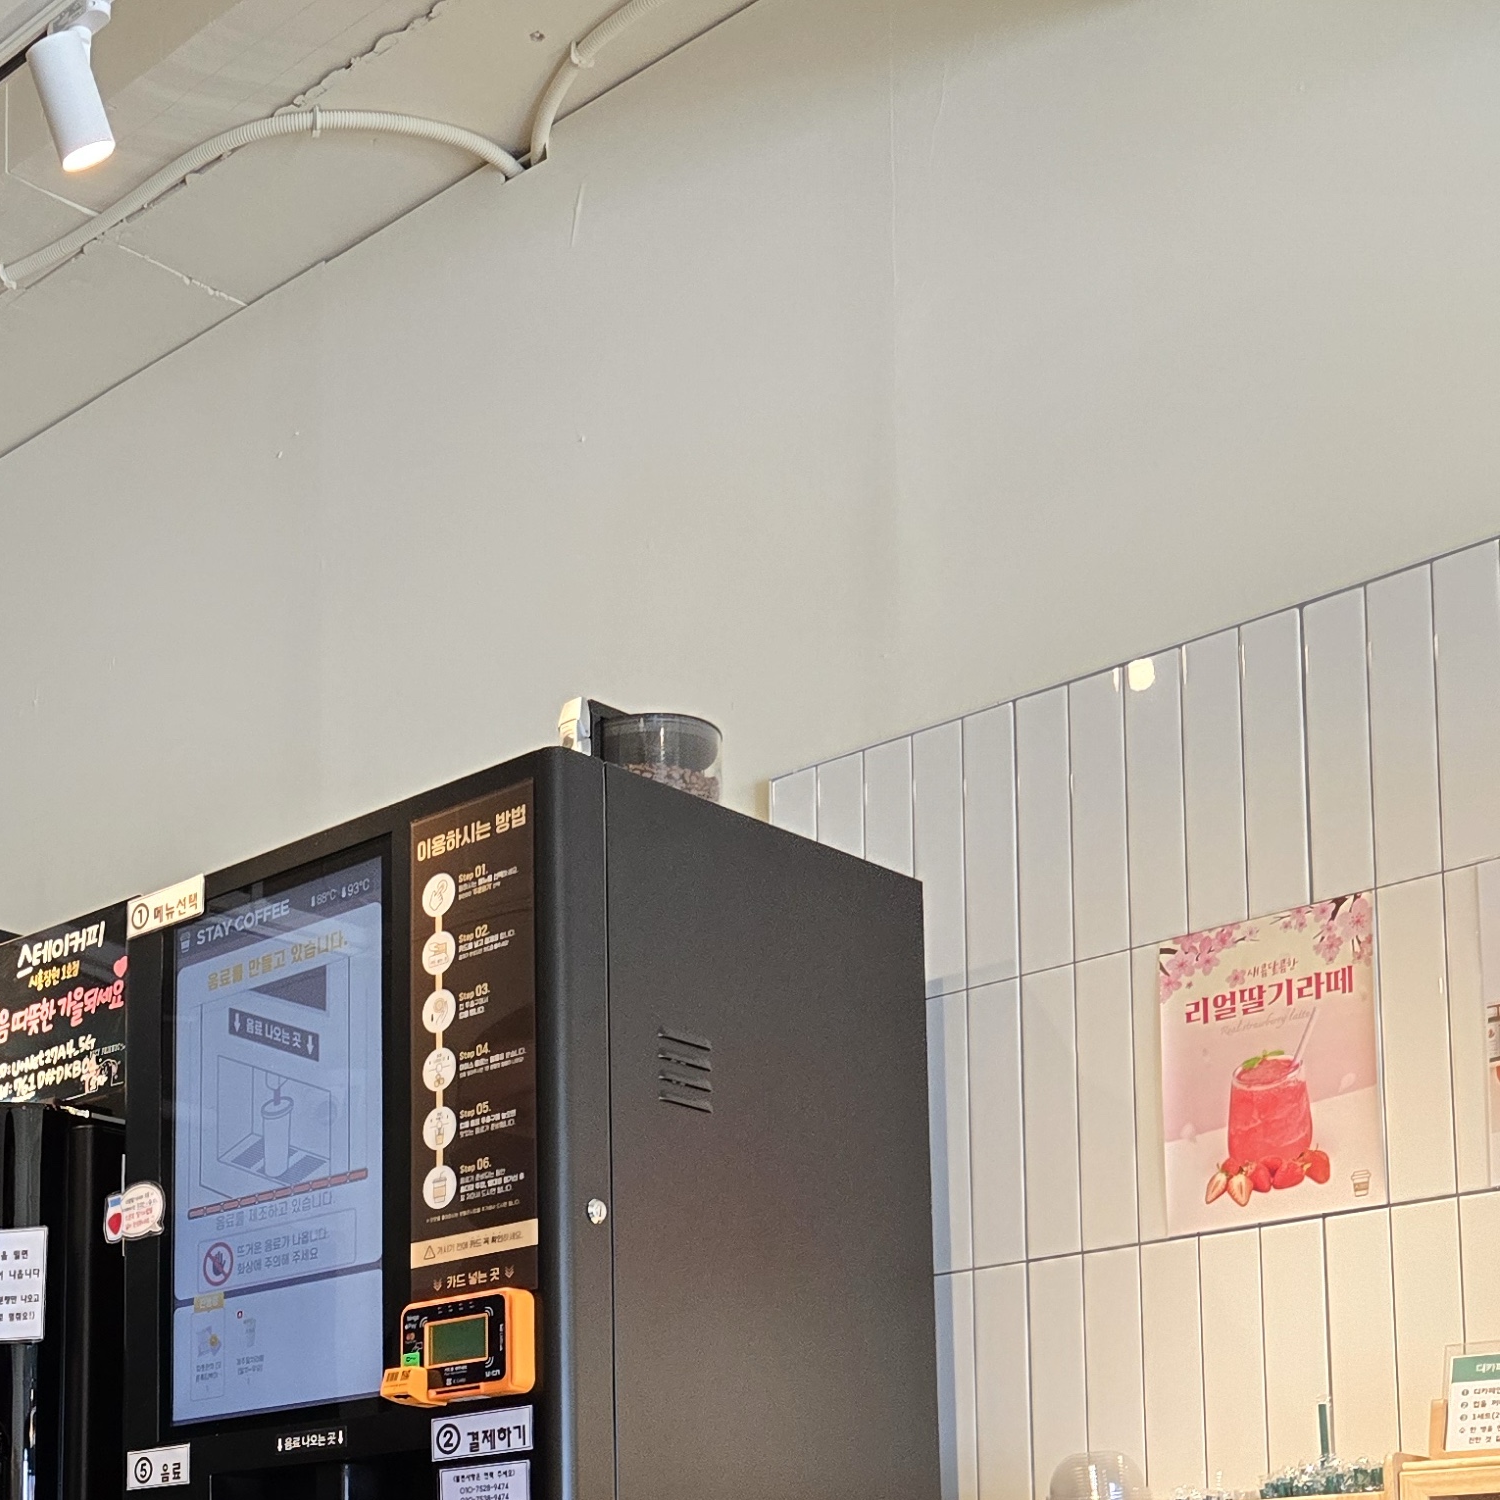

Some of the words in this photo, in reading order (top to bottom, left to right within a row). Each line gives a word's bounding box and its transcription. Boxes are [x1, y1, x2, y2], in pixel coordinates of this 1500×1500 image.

[417, 820, 491, 861] 이용하시는
[495, 804, 526, 834] 방법
[458, 872, 474, 883] Step
[153, 892, 198, 923] 메뉴선택
[196, 919, 233, 945] STAY
[234, 899, 290, 932] COFFEE
[16, 920, 105, 979] 스테이커피
[459, 933, 474, 943] Step
[207, 963, 243, 991] 음료를
[248, 951, 286, 977] 만들고
[459, 991, 475, 1001] Step
[1185, 965, 1354, 1024] 리얼딸기라떼
[11, 997, 55, 1036] 따뜻한
[246, 1017, 263, 1036] 음료
[265, 1022, 290, 1045] 나오는
[292, 1033, 301, 1048] 곳
[459, 1050, 475, 1061] Step
[459, 1109, 475, 1119] Step
[460, 1164, 475, 1174] Step
[215, 1211, 244, 1231] 음료를
[249, 1201, 288, 1223] 제조하고
[237, 1241, 262, 1258] 뜨거운
[264, 1235, 290, 1255] 음료가
[237, 1258, 262, 1275] 화상에
[264, 1253, 290, 1270] 주의해
[292, 1247, 319, 1264] 주세요
[447, 1273, 466, 1288] 카드
[468, 1270, 488, 1285] 넣는
[490, 1267, 500, 1281] 곳
[284, 1436, 301, 1450] 음료
[302, 1433, 326, 1448] 나오는
[327, 1431, 336, 1445] 곳
[467, 1424, 526, 1452] 결제하기
[160, 1462, 181, 1483] 음료
[460, 1482, 509, 1494] 010-7528-9474
